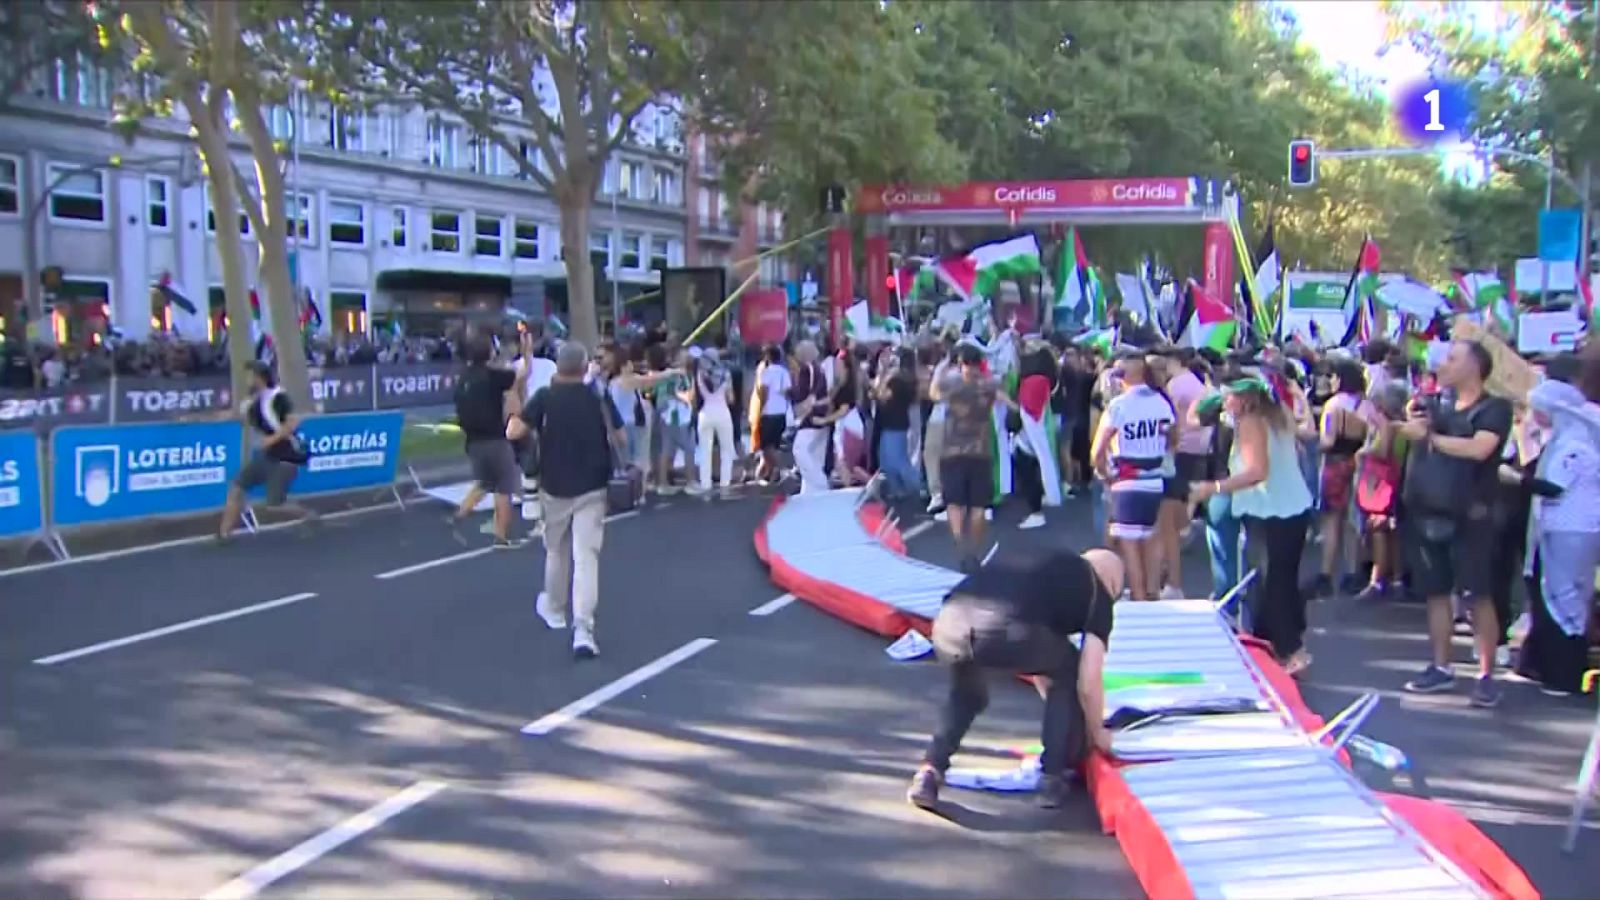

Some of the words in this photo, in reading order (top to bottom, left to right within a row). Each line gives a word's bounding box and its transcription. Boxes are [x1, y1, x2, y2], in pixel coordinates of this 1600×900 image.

[994, 187, 1056, 203] Cofidis
[1112, 183, 1177, 201] Cofidis
[309, 429, 388, 453] LOTERÍAS
[127, 441, 227, 469] LOTERÍAS
